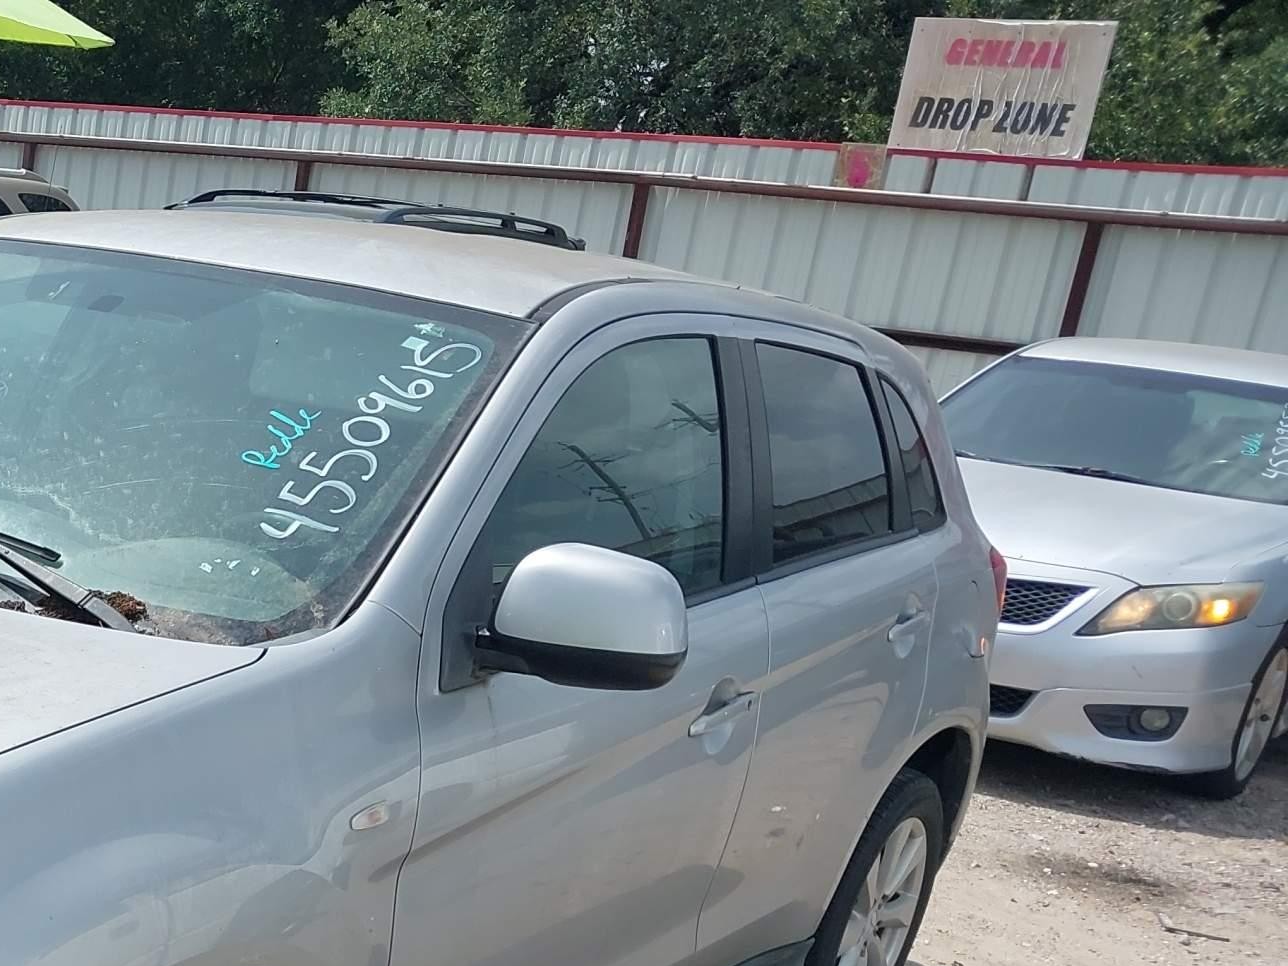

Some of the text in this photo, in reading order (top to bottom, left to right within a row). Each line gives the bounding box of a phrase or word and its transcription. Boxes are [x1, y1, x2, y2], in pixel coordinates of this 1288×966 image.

[945, 38, 1067, 69] GENERAL
[908, 95, 1076, 137] DROP ZONE
[259, 336, 482, 540] 45509615
